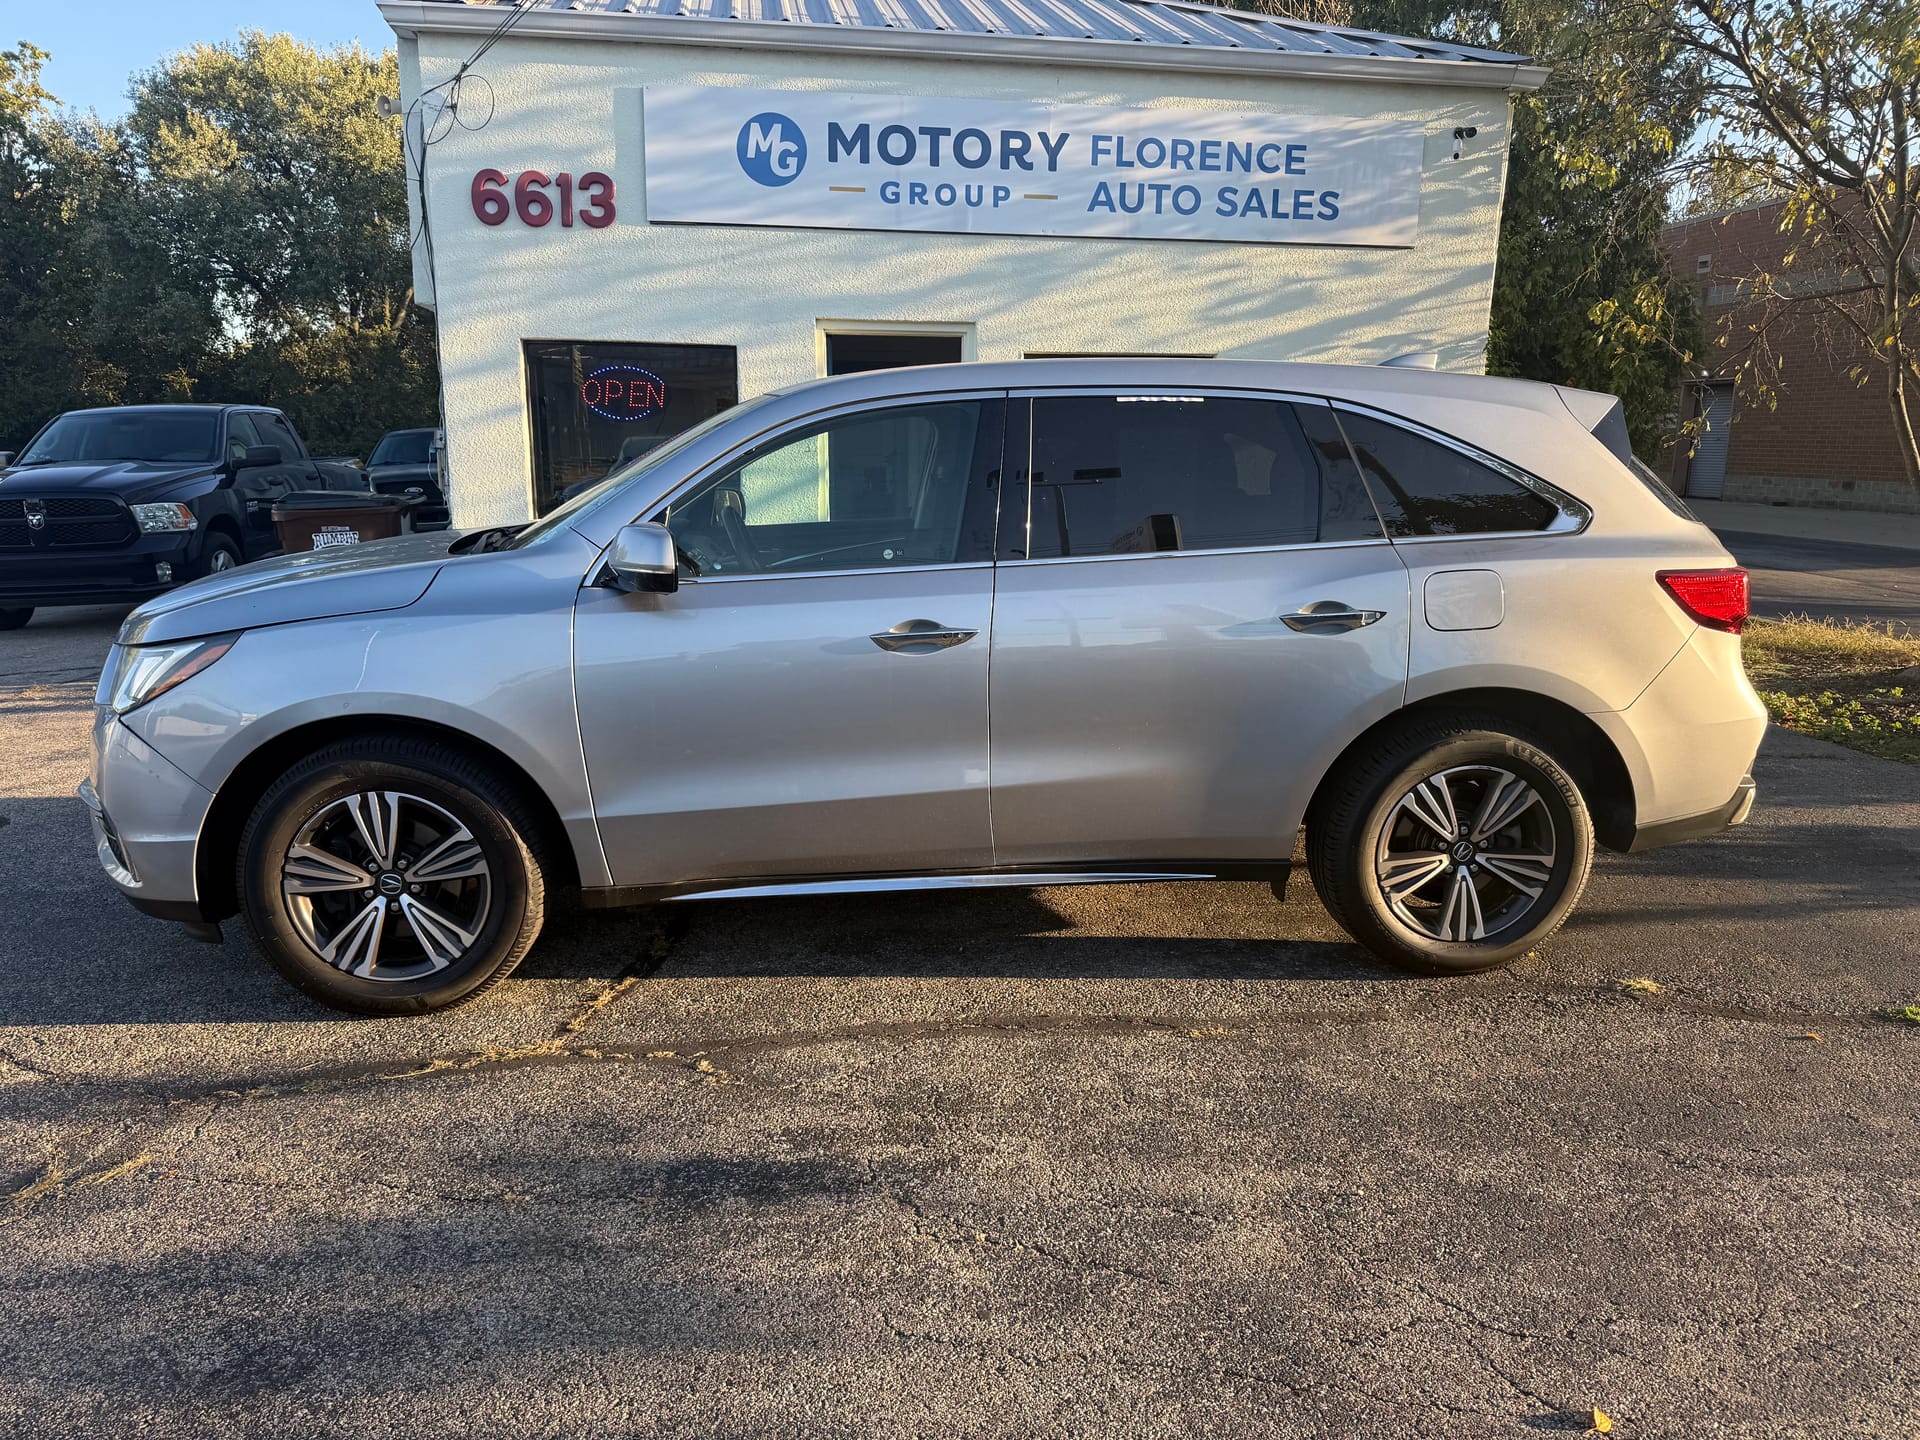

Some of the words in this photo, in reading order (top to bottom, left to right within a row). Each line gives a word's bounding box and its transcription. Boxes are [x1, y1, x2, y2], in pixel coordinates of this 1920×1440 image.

[746, 121, 799, 178] MG
[827, 121, 1071, 172] MOTORY
[1090, 134, 1308, 176] FLORENCE
[470, 168, 617, 229] 6613
[879, 180, 1012, 208] GROUP
[1086, 180, 1203, 217] AUTO
[1214, 185, 1341, 223] SALES
[581, 378, 666, 409] OPEN
[1531, 755, 1579, 807] MICHELIN
